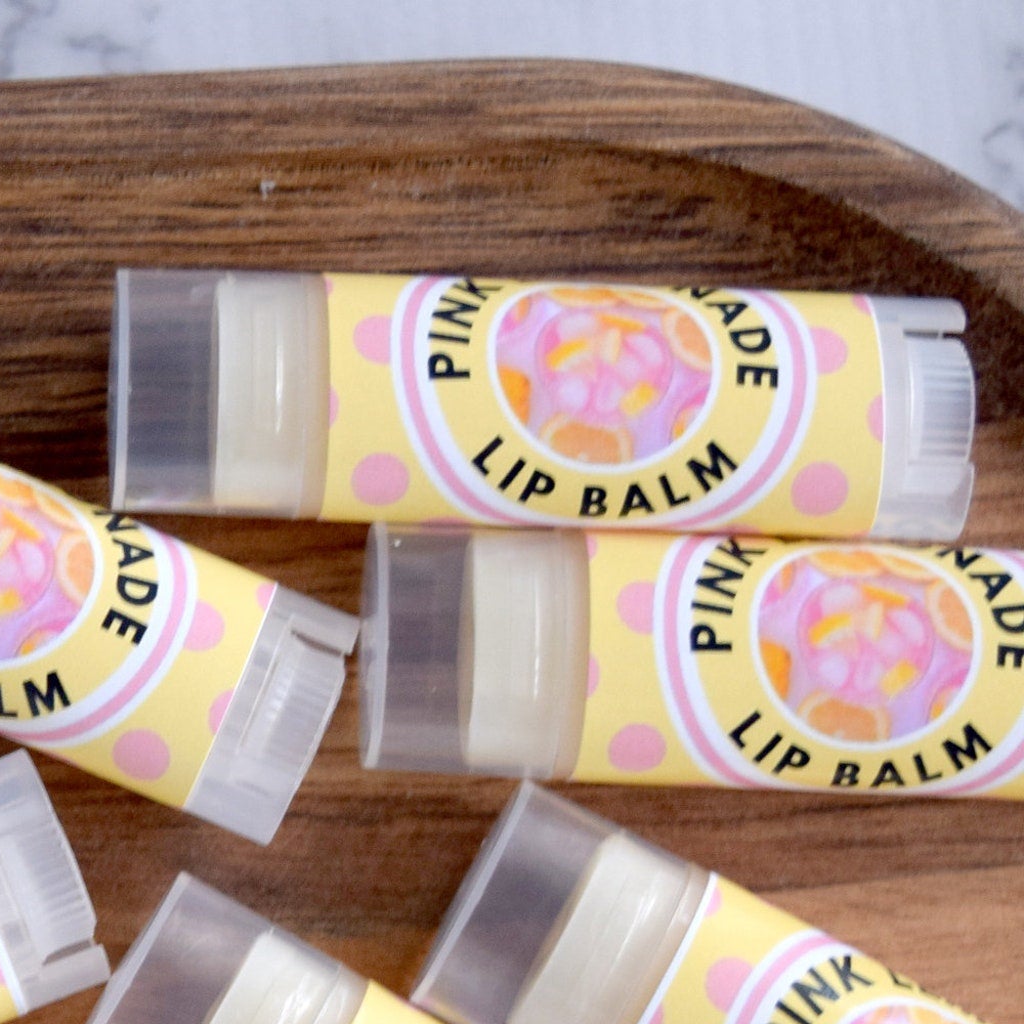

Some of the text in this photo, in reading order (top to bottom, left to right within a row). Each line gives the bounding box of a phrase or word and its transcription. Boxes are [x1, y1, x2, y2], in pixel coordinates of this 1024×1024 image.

[428, 278, 504, 381] PINK
[471, 435, 740, 517] LIP BALM
[690, 536, 768, 653] PINK
[728, 711, 993, 788] LIP BALM
